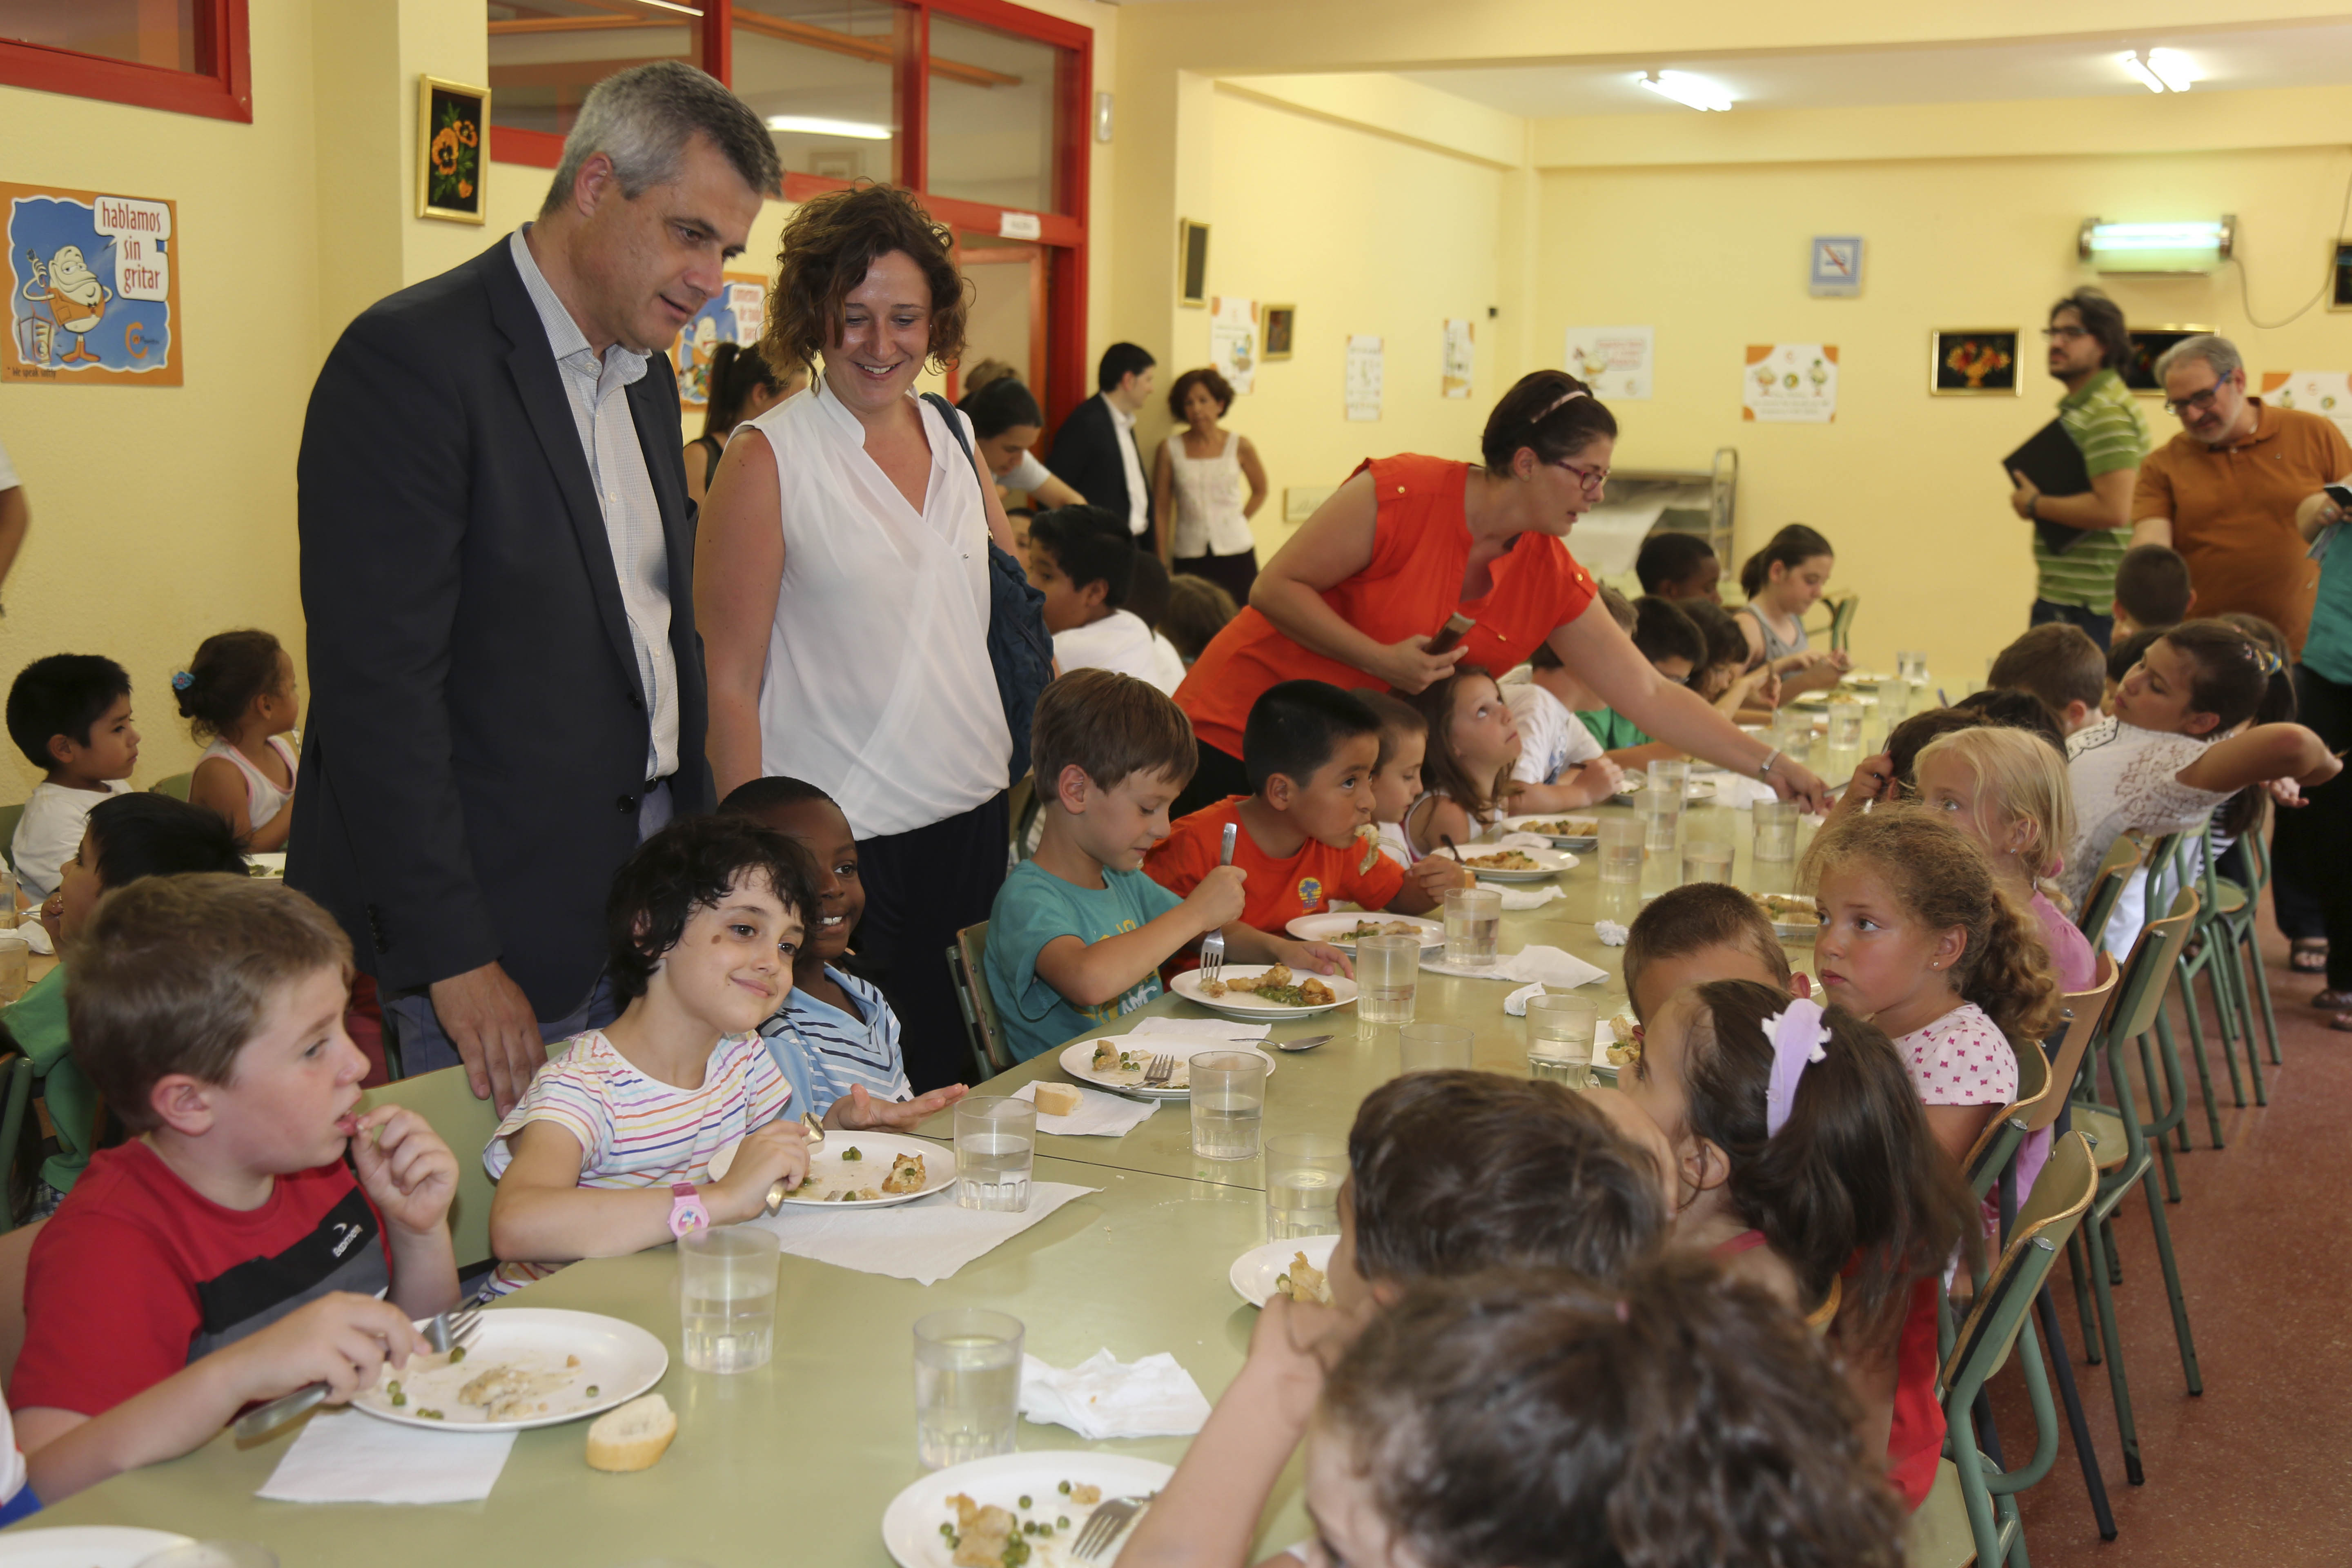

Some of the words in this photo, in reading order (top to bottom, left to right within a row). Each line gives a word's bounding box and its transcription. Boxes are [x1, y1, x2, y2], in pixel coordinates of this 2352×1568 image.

[102, 201, 160, 232] hablamos
[124, 235, 141, 260] sin
[124, 264, 160, 294] gritar
